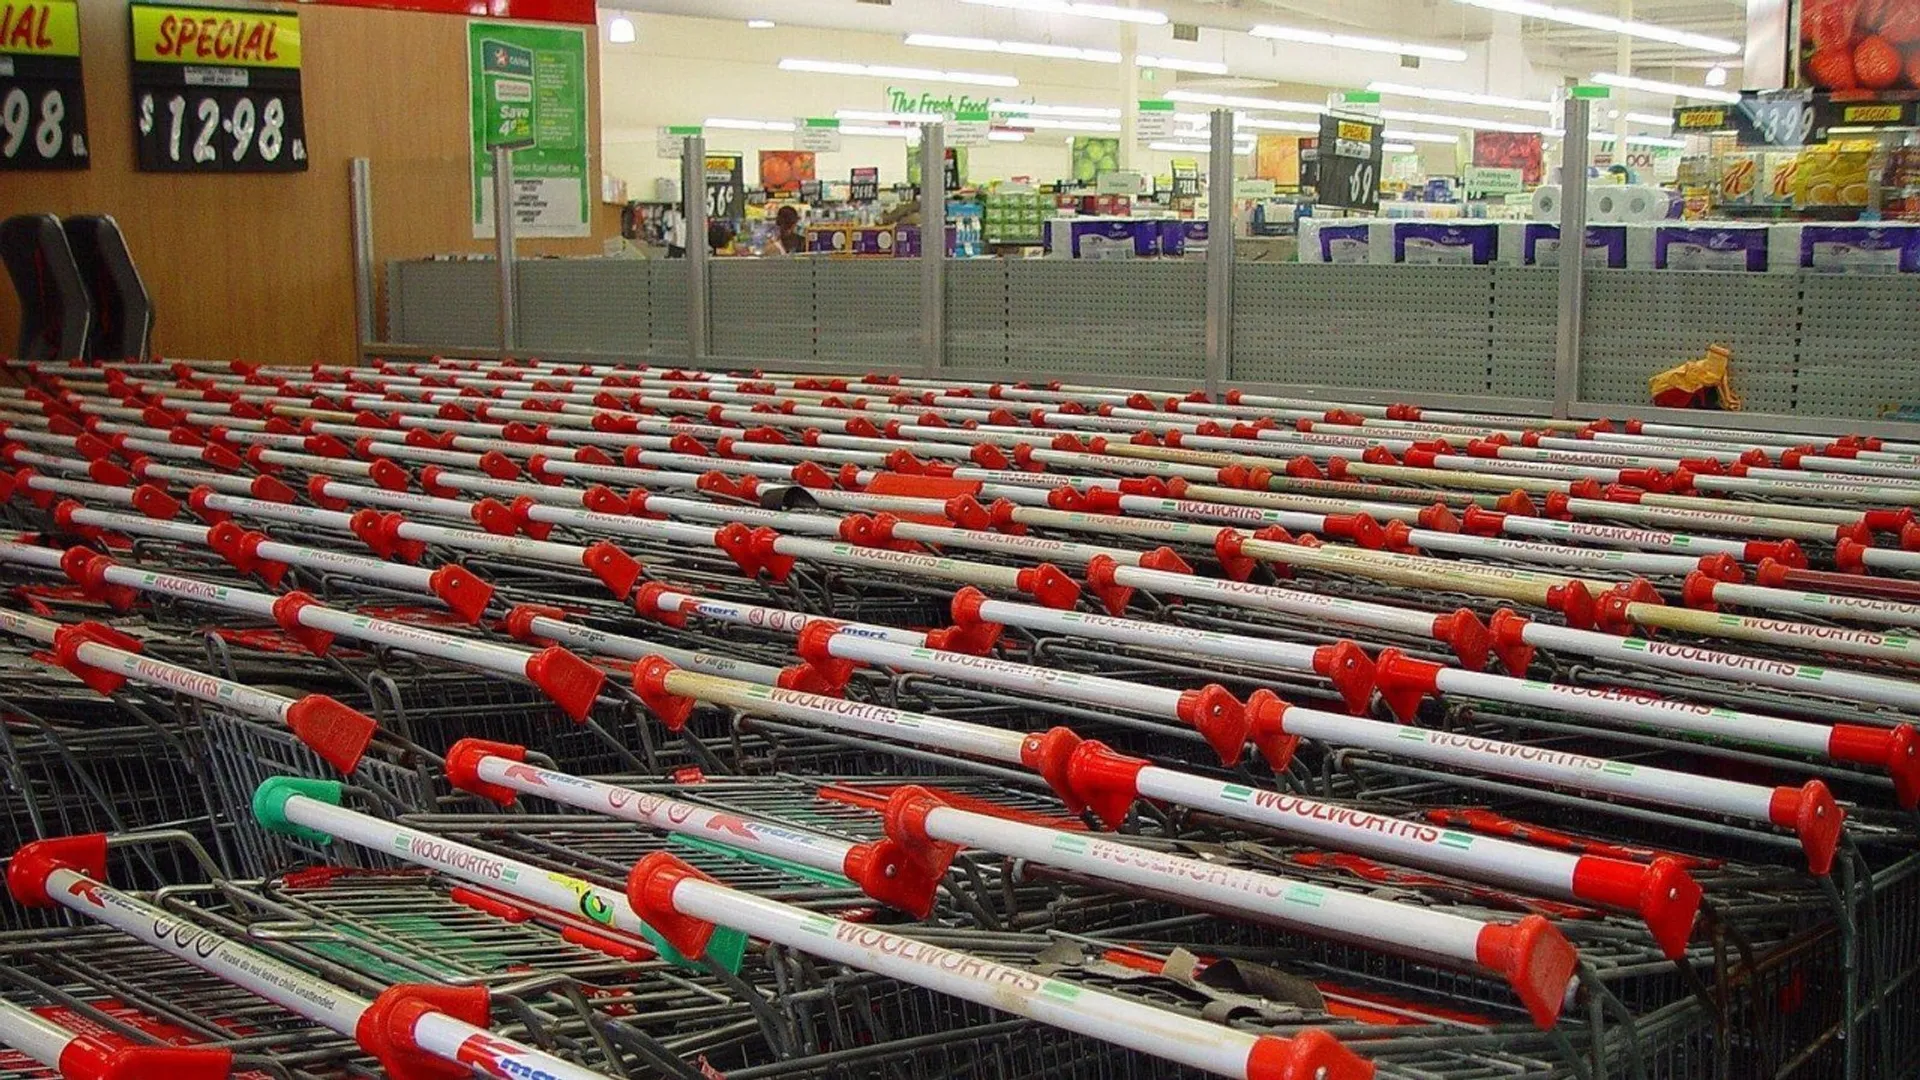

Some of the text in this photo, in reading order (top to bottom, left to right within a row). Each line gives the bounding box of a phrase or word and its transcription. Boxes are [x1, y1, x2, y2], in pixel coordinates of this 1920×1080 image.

[155, 14, 279, 61] SPECIAL
[499, 106, 529, 119] Save
[920, 93, 954, 113] Fresh
[958, 95, 989, 112] Food
[1177, 502, 1262, 520] WOOLWORTHS
[1572, 523, 1671, 545] WOOLWORTHS
[1743, 618, 1883, 645] WOOLWORTHS
[1648, 640, 1796, 676] WOOLWORTHS
[138, 660, 218, 696] WOOLWORTHS
[770, 688, 898, 723] WOOLWORTHS
[1430, 731, 1603, 770] WOOLWORTHS
[1255, 791, 1439, 842] WOOLWORTHS
[411, 839, 503, 879] WOOLWORTHS
[219, 949, 239, 966] Please
[240, 960, 250, 970] do
[251, 964, 262, 976] not
[262, 969, 278, 985] leave
[279, 977, 296, 992] child
[836, 922, 1041, 990] WOOLWORTHS
